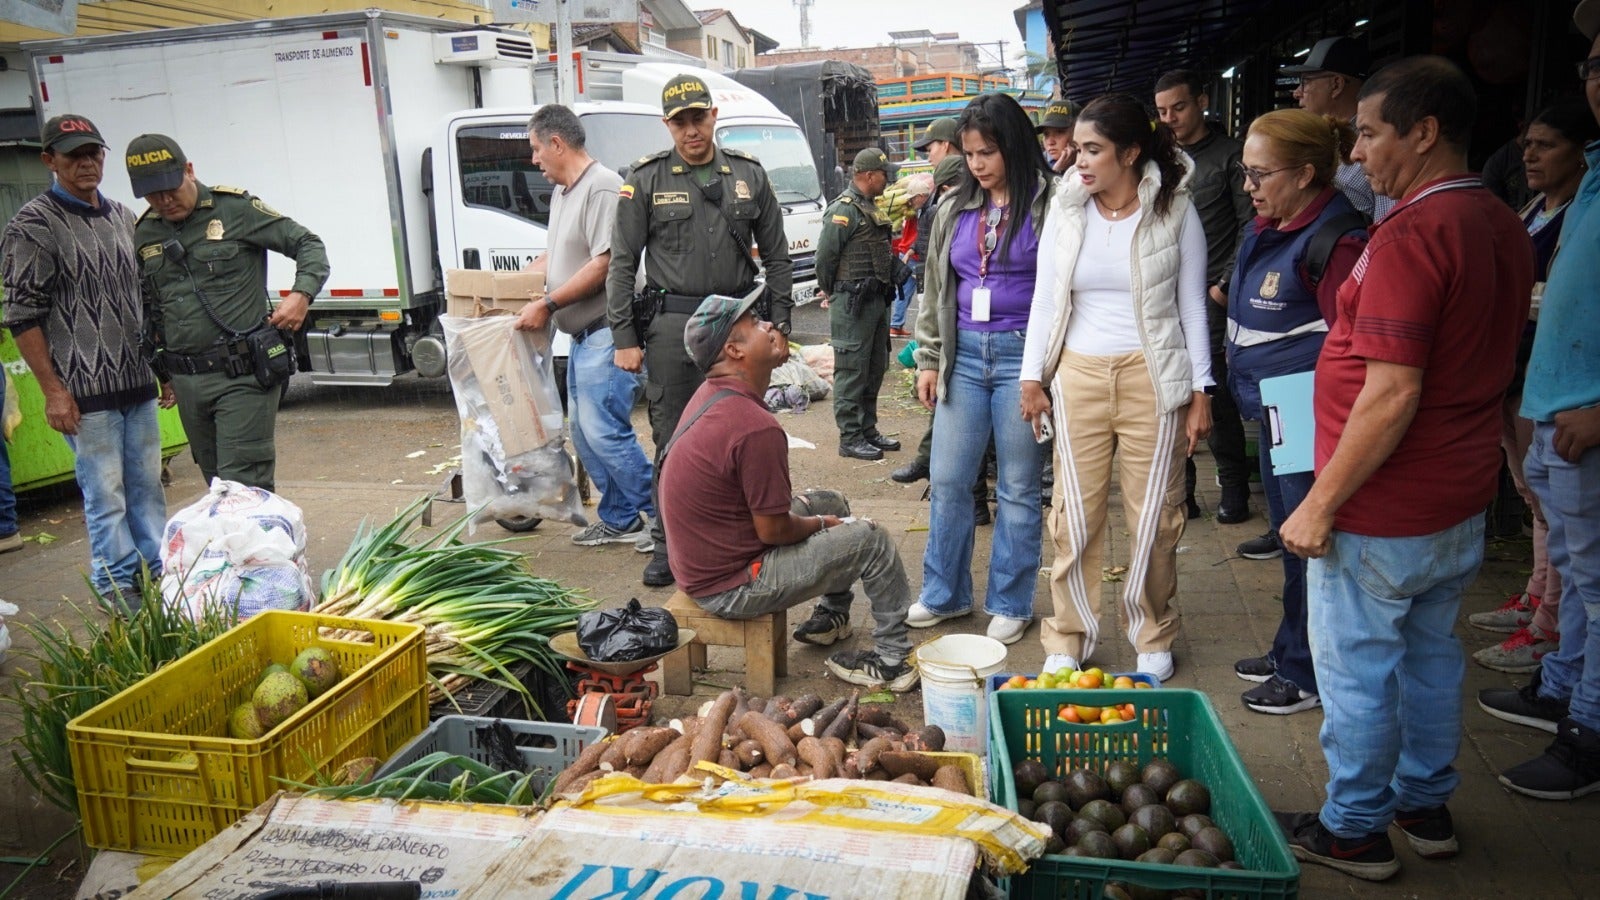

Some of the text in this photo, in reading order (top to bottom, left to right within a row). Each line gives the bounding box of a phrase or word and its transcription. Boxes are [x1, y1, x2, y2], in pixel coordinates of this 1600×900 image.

[275, 46, 354, 62] TRANSPORTE DE ALIMENTOS
[664, 81, 704, 101] POLICIA
[60, 119, 93, 133] CNN
[127, 149, 173, 168] POLICIA
[789, 239, 810, 250] JAC
[492, 255, 520, 271] WNN
